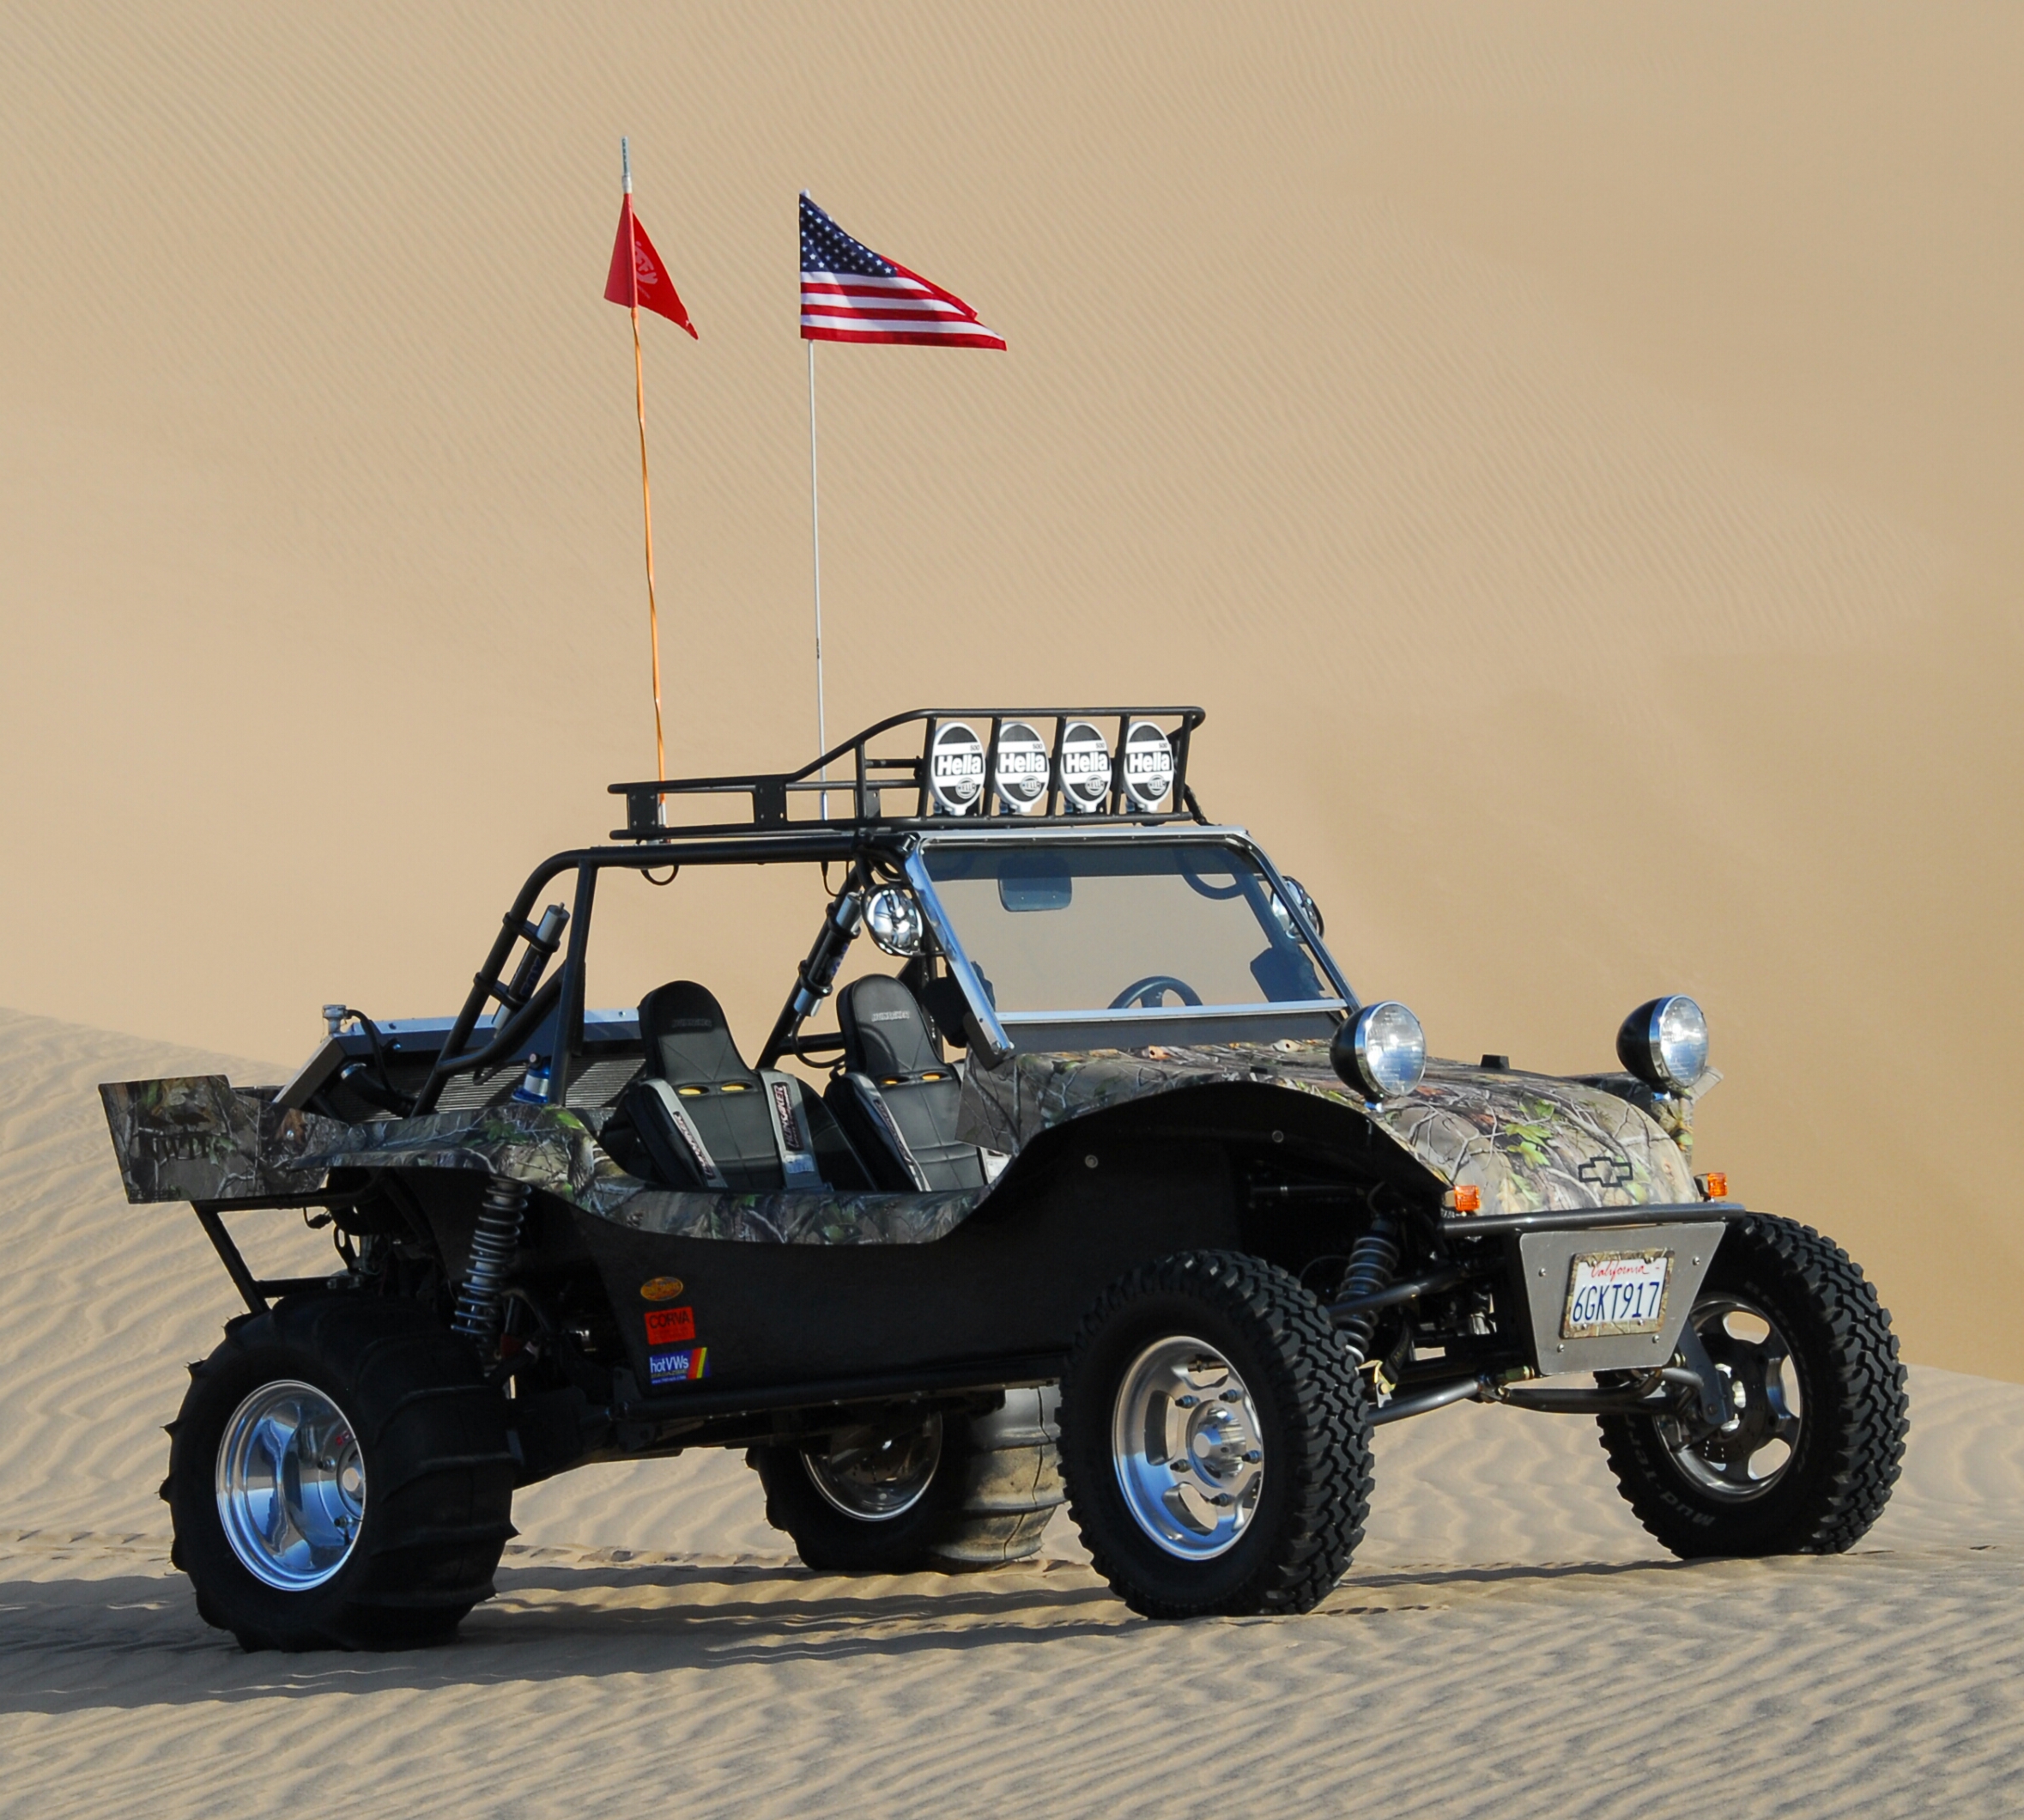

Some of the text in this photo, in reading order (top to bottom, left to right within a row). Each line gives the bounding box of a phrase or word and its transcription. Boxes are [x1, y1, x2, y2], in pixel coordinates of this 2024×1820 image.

[936, 754, 982, 776] Hella
[999, 752, 1045, 774] Hella
[1065, 751, 1108, 774] Hella
[1129, 751, 1171, 774] Hella
[1591, 1260, 1650, 1282] California
[1573, 1282, 1660, 1322] 6GKT917
[649, 1310, 690, 1329] CORVA
